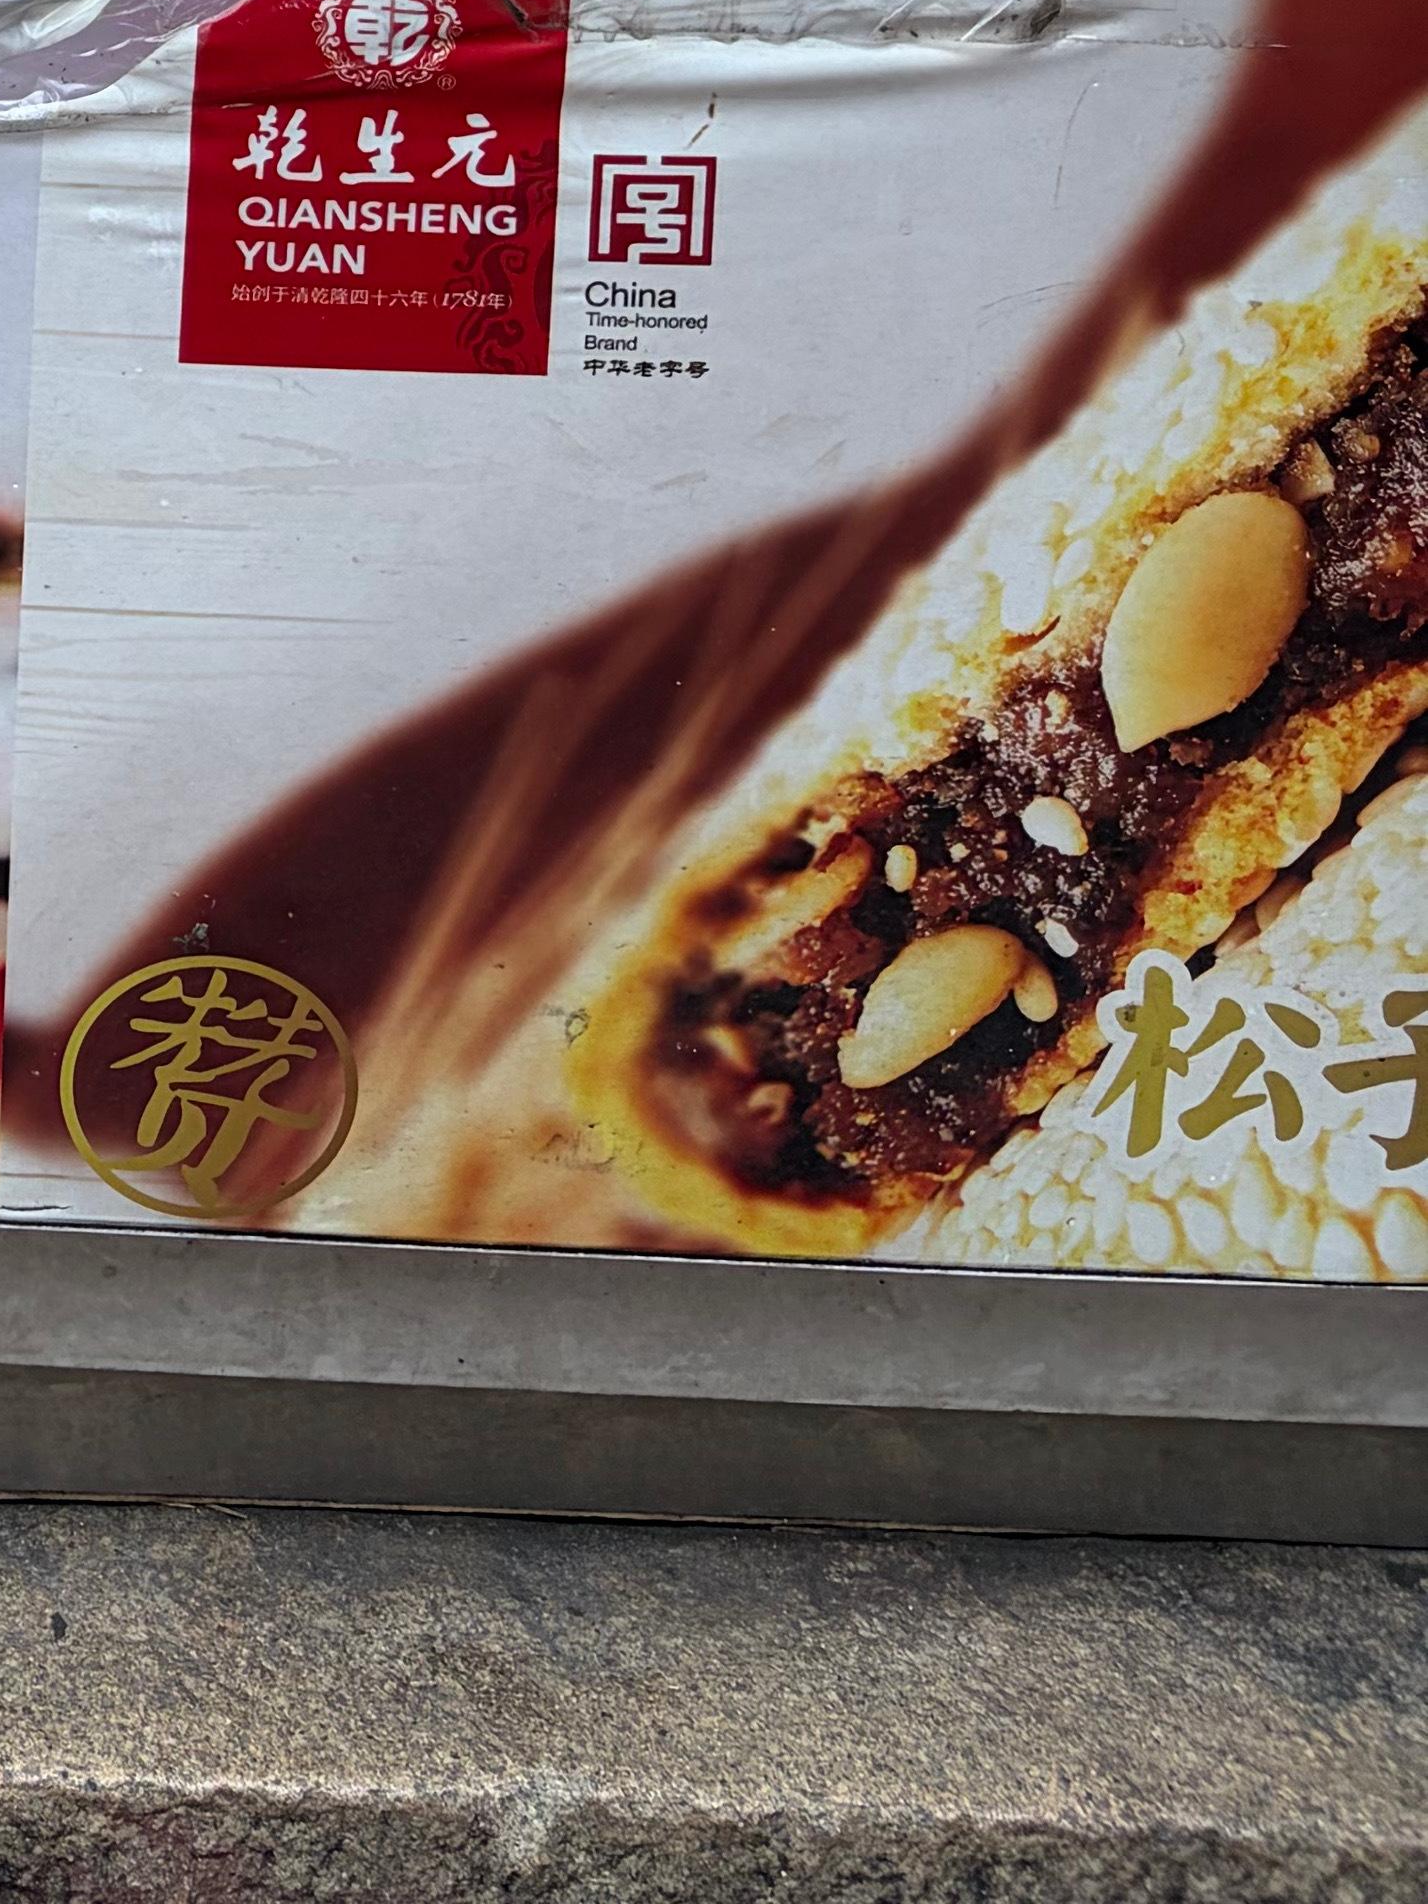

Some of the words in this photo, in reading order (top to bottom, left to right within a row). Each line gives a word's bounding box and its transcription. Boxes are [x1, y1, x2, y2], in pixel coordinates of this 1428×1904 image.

[233, 104, 516, 187] 乾生元
[237, 196, 518, 236] QIANSHENG
[235, 239, 365, 275] YUAN
[585, 281, 677, 308] China
[585, 312, 708, 330] Time-honored
[585, 334, 638, 351] Brand
[583, 358, 710, 379] 中华老字号
